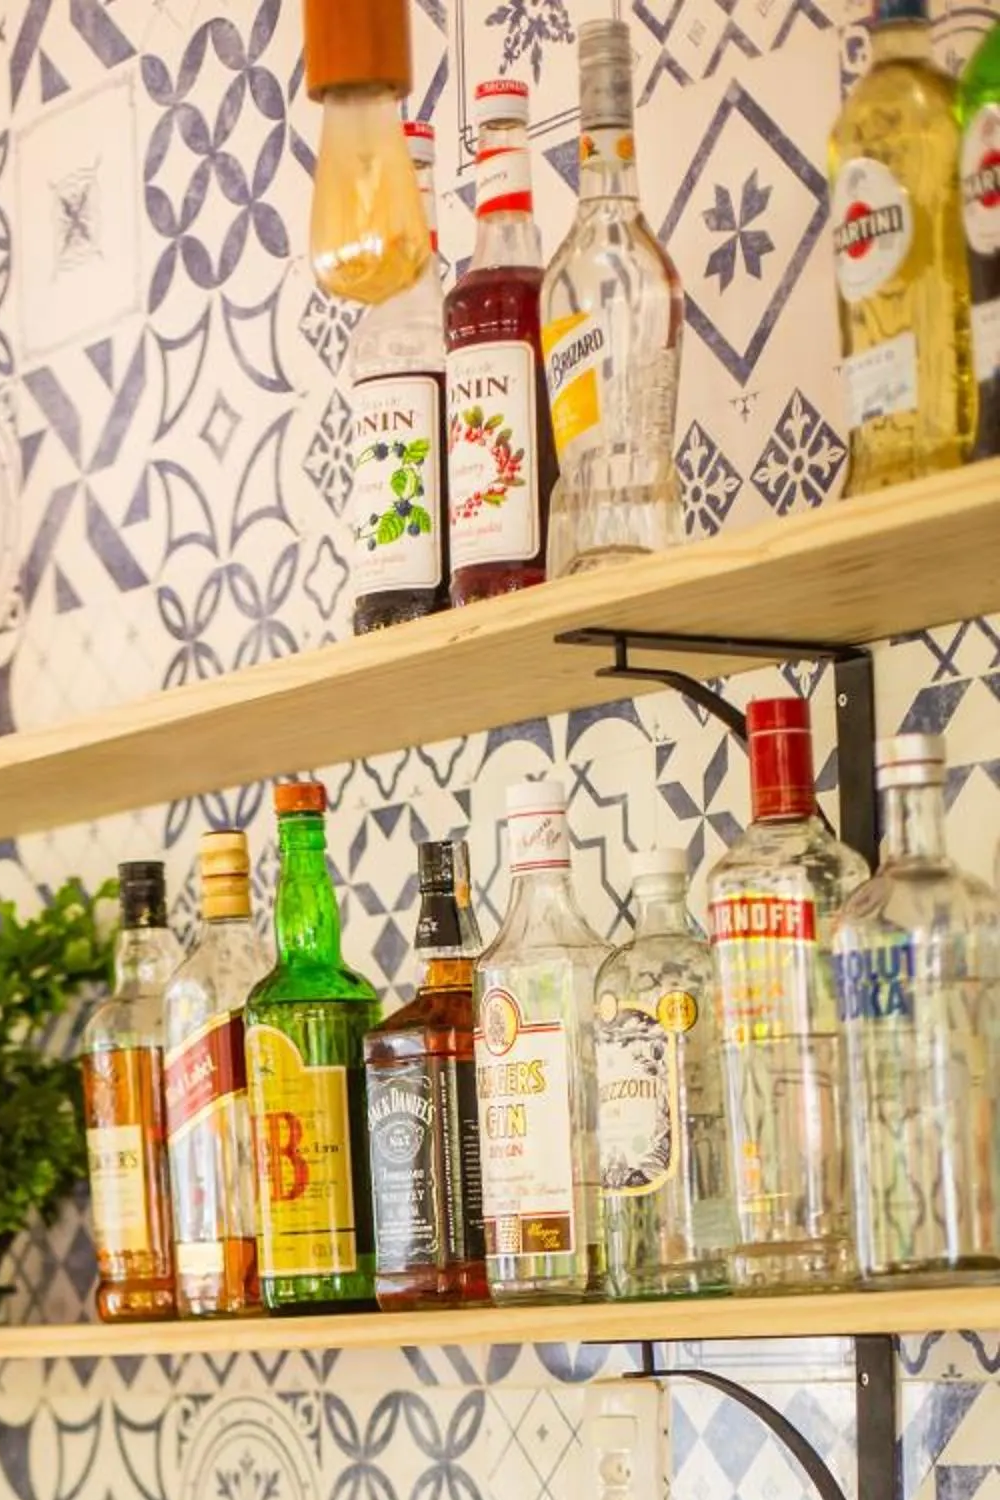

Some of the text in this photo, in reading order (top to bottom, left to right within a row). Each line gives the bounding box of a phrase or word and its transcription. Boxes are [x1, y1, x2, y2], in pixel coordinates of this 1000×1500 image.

[834, 204, 904, 253] MARTINI
[551, 327, 604, 390] BRIZARD
[357, 409, 415, 437] NIN
[714, 902, 801, 933] IRNOFF
[486, 1103, 527, 1139] GIN
